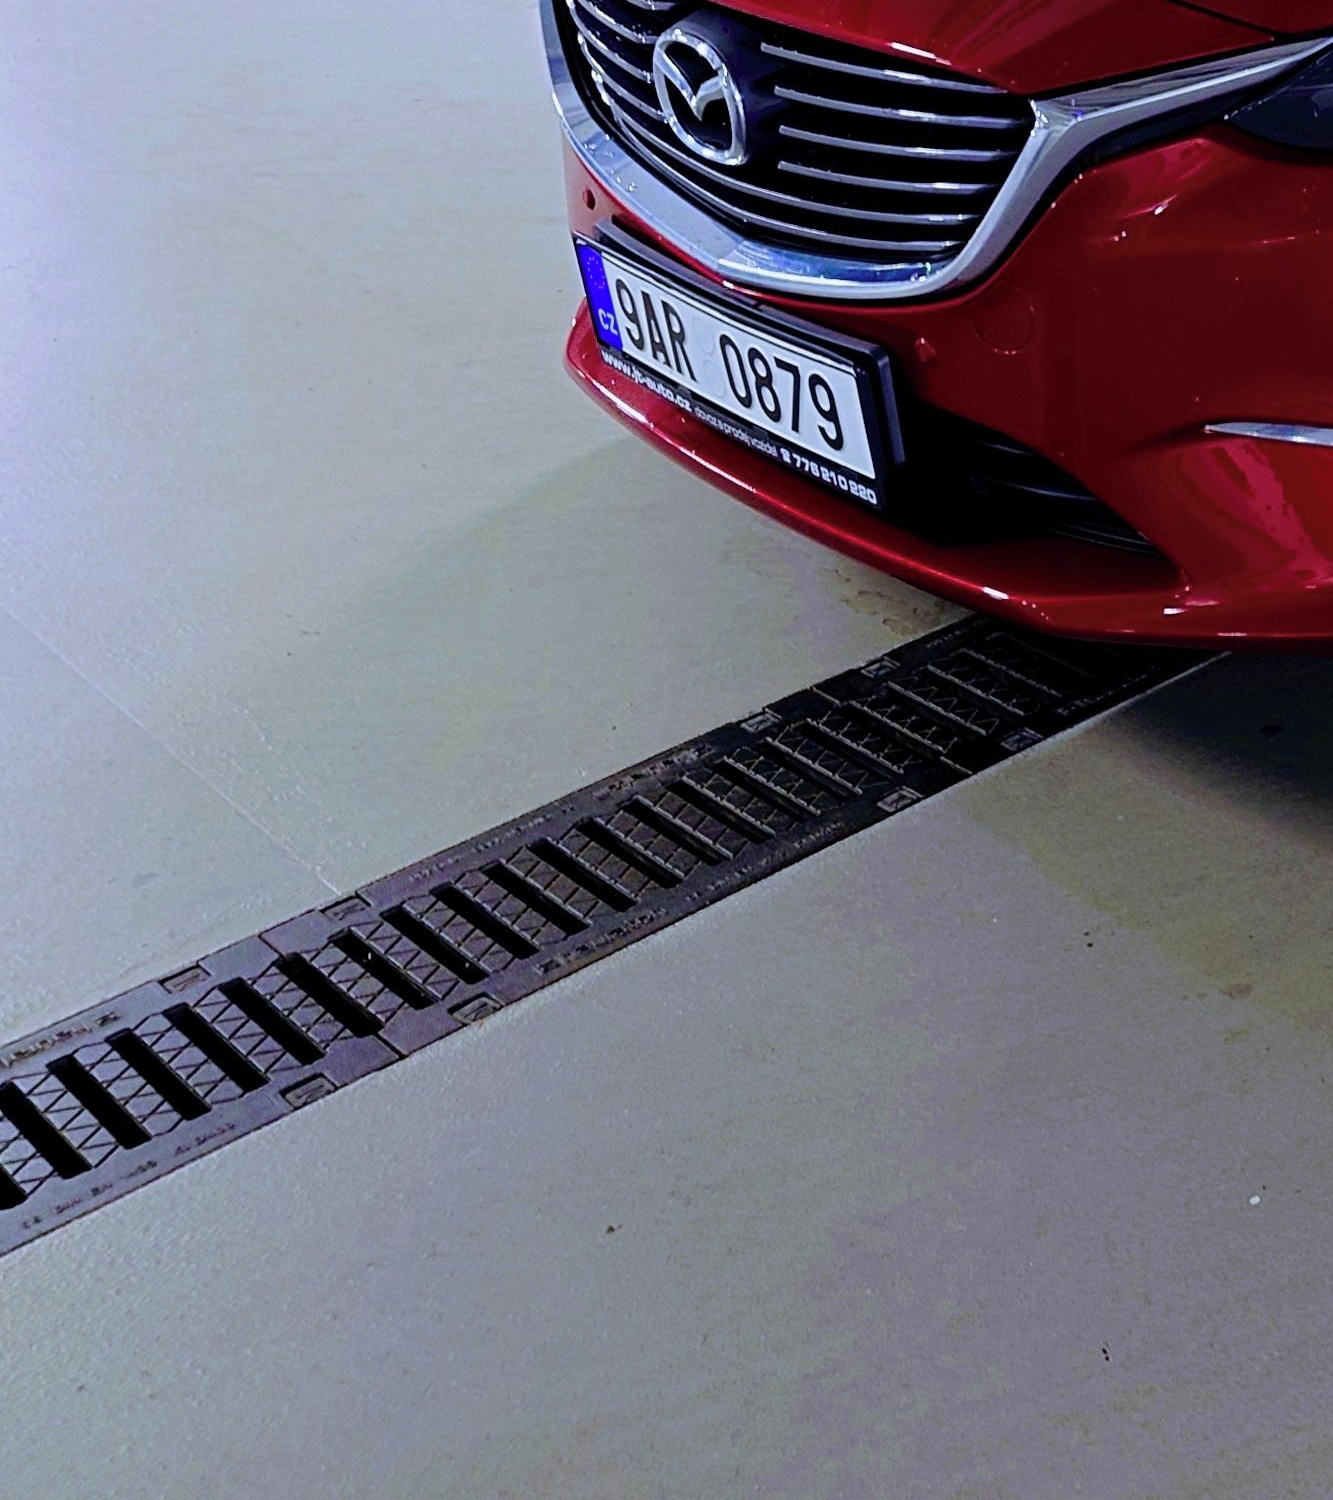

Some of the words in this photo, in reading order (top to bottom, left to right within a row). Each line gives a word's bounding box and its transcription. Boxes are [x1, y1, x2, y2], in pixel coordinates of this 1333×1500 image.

[597, 307, 619, 337] CZ
[615, 277, 698, 383] 9AR
[719, 333, 845, 451] 0879
[848, 479, 878, 505] 220
